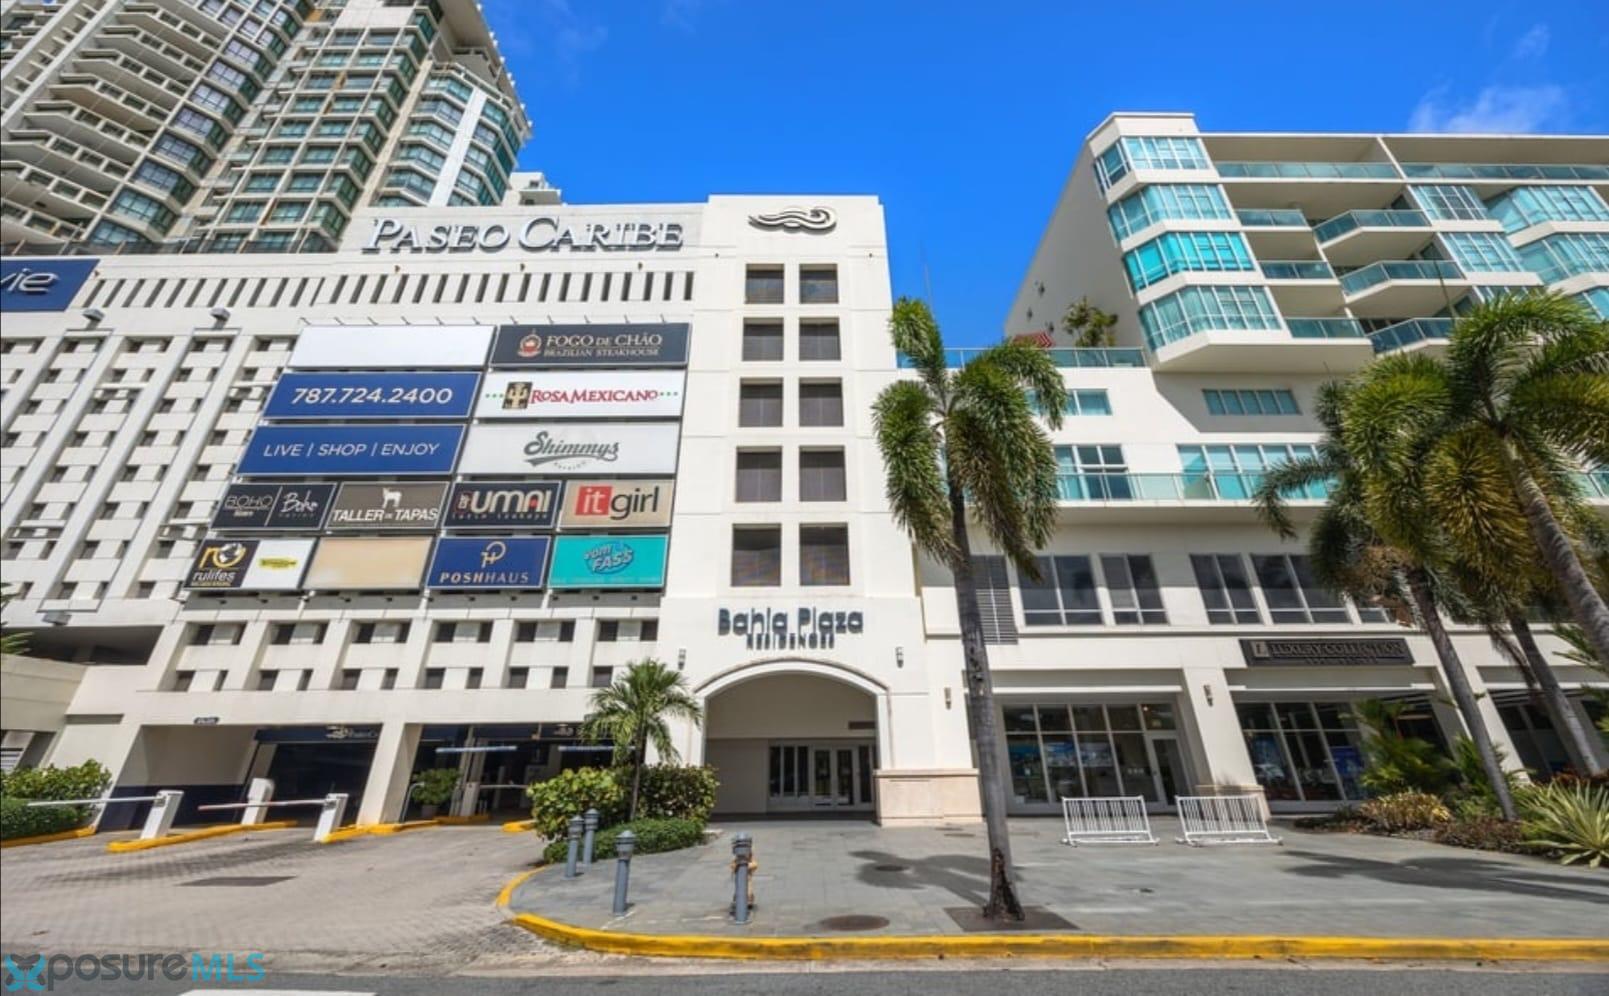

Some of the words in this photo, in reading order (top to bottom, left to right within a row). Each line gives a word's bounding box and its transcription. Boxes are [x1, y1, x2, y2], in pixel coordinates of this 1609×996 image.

[361, 216, 511, 254] PASEO
[518, 215, 684, 252] CARIBE
[546, 334, 594, 347] FOGO
[596, 337, 610, 347] DE
[614, 331, 663, 347] CHÃO
[291, 387, 454, 405] 787.724.2400
[530, 389, 570, 404] ROSA
[569, 388, 658, 404] MEXICANO
[263, 443, 304, 457] LIVE
[317, 443, 367, 457] SHOP
[380, 442, 440, 456] ENJOY
[523, 430, 620, 463] Shimmys
[580, 485, 606, 514] it
[609, 485, 660, 520] girl
[333, 508, 385, 521] TALLER
[394, 507, 439, 521] TAPAS
[439, 571, 529, 584] POSHHAUS
[718, 607, 788, 636] Bahia
[797, 606, 864, 634] Plaza
